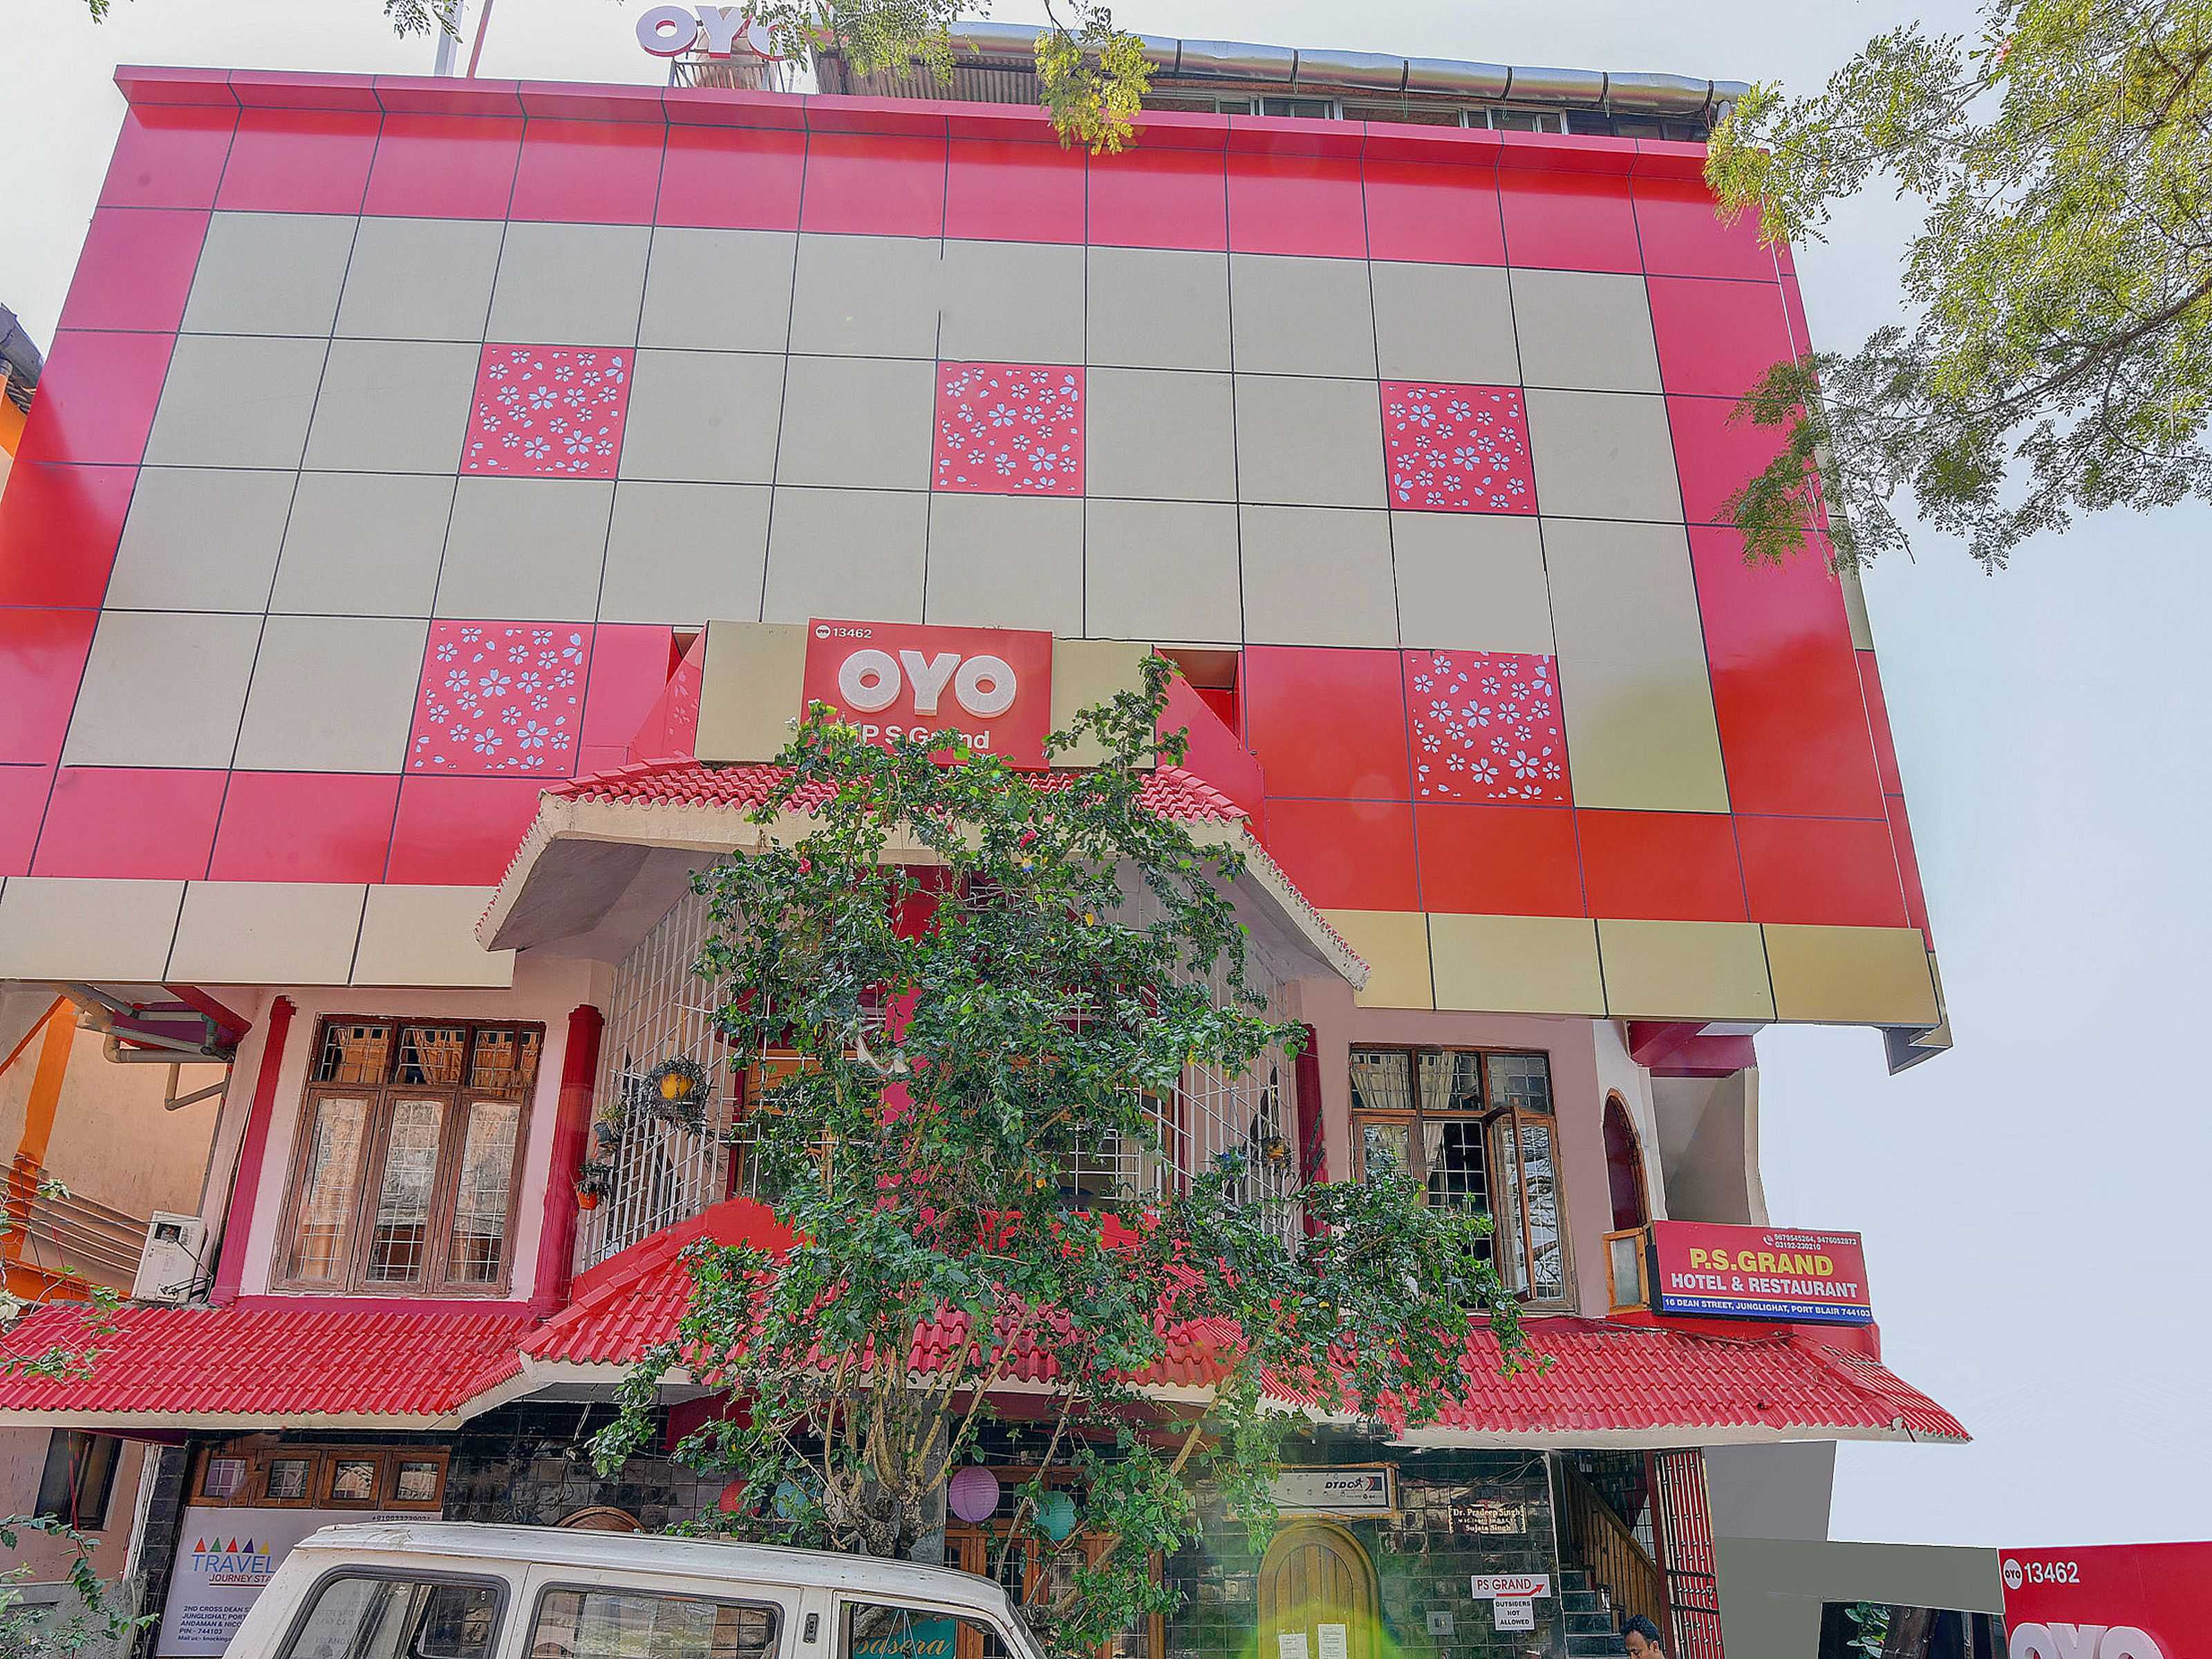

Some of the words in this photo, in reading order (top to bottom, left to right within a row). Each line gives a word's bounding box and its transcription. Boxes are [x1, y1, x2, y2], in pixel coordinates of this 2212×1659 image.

[833, 628, 872, 638] 13462
[838, 649, 1017, 718] OYO
[908, 727, 990, 750] Gnd
[1689, 1248, 1834, 1276] P.S.GRAND
[1671, 1273, 1727, 1291] HOTEL
[1732, 1276, 1745, 1292] &
[1748, 1277, 1858, 1298] RESTAURANT
[1677, 1299, 1699, 1307] DEAN
[1701, 1300, 1734, 1310] STREET,
[1736, 1302, 1790, 1313] JUNGLIGHAT,
[1791, 1305, 1814, 1313] PORT
[1815, 1306, 1839, 1315] BLAIR
[1841, 1309, 1871, 1317] 744103
[191, 1555, 276, 1573] TRAVEL
[2005, 1569, 2021, 1579] OYO
[2025, 1562, 2080, 1584] 13462
[209, 1574, 252, 1582] JOURNEY
[1477, 1579, 1489, 1590] PS
[1492, 1579, 1531, 1590] GRAND
